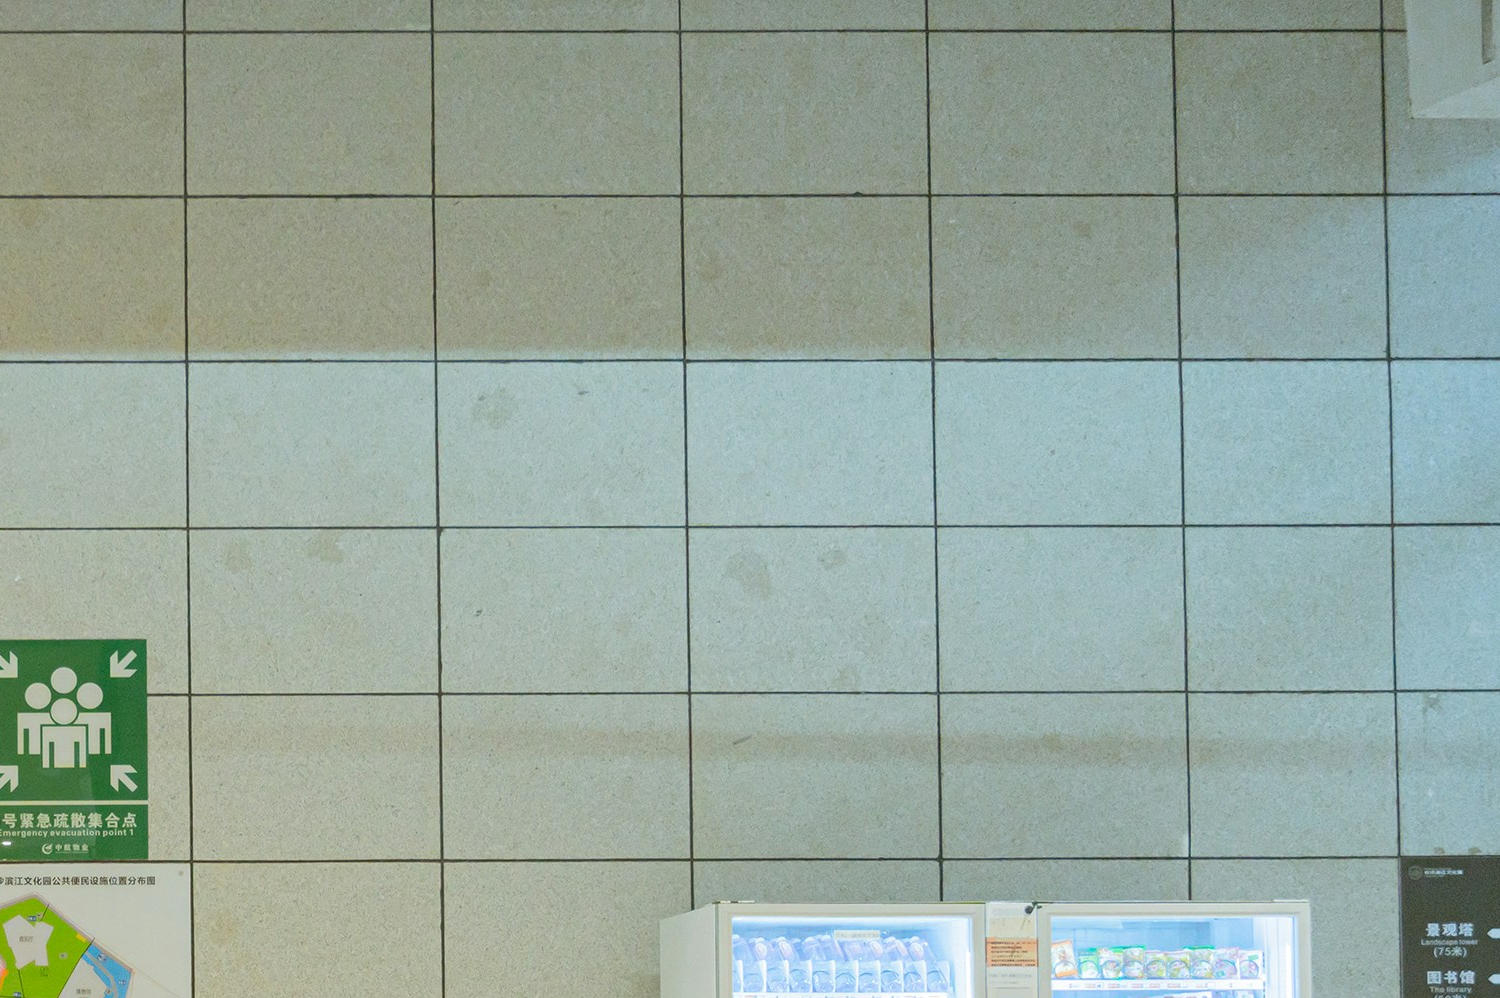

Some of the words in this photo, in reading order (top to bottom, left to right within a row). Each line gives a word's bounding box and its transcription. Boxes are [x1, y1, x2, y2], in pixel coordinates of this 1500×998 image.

[102, 828, 127, 837] point
[1425, 923, 1474, 937] 景观塔
[1426, 971, 1476, 985] 图书馆
[1446, 986, 1472, 994] library
